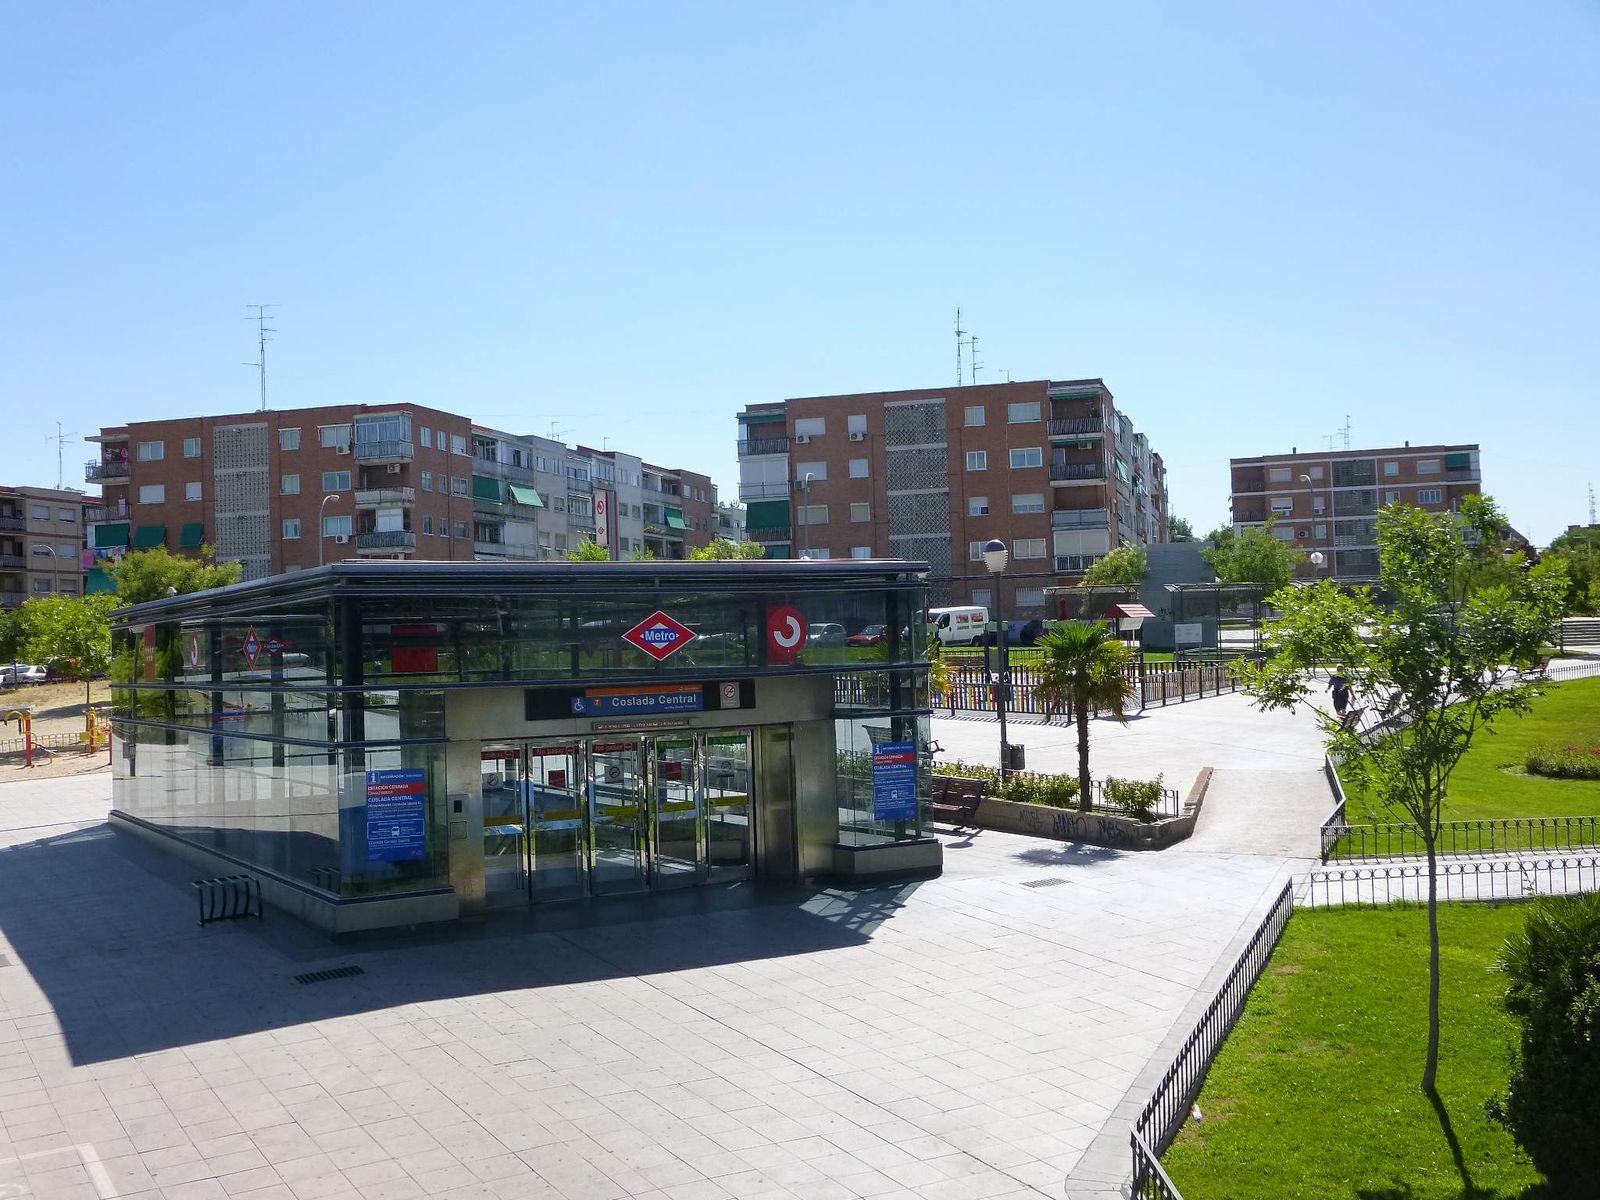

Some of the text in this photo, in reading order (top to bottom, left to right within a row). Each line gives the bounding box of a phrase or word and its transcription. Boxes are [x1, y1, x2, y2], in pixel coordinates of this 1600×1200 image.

[645, 630, 676, 640] Metro
[612, 696, 655, 707] Coslada
[658, 694, 696, 704] Central
